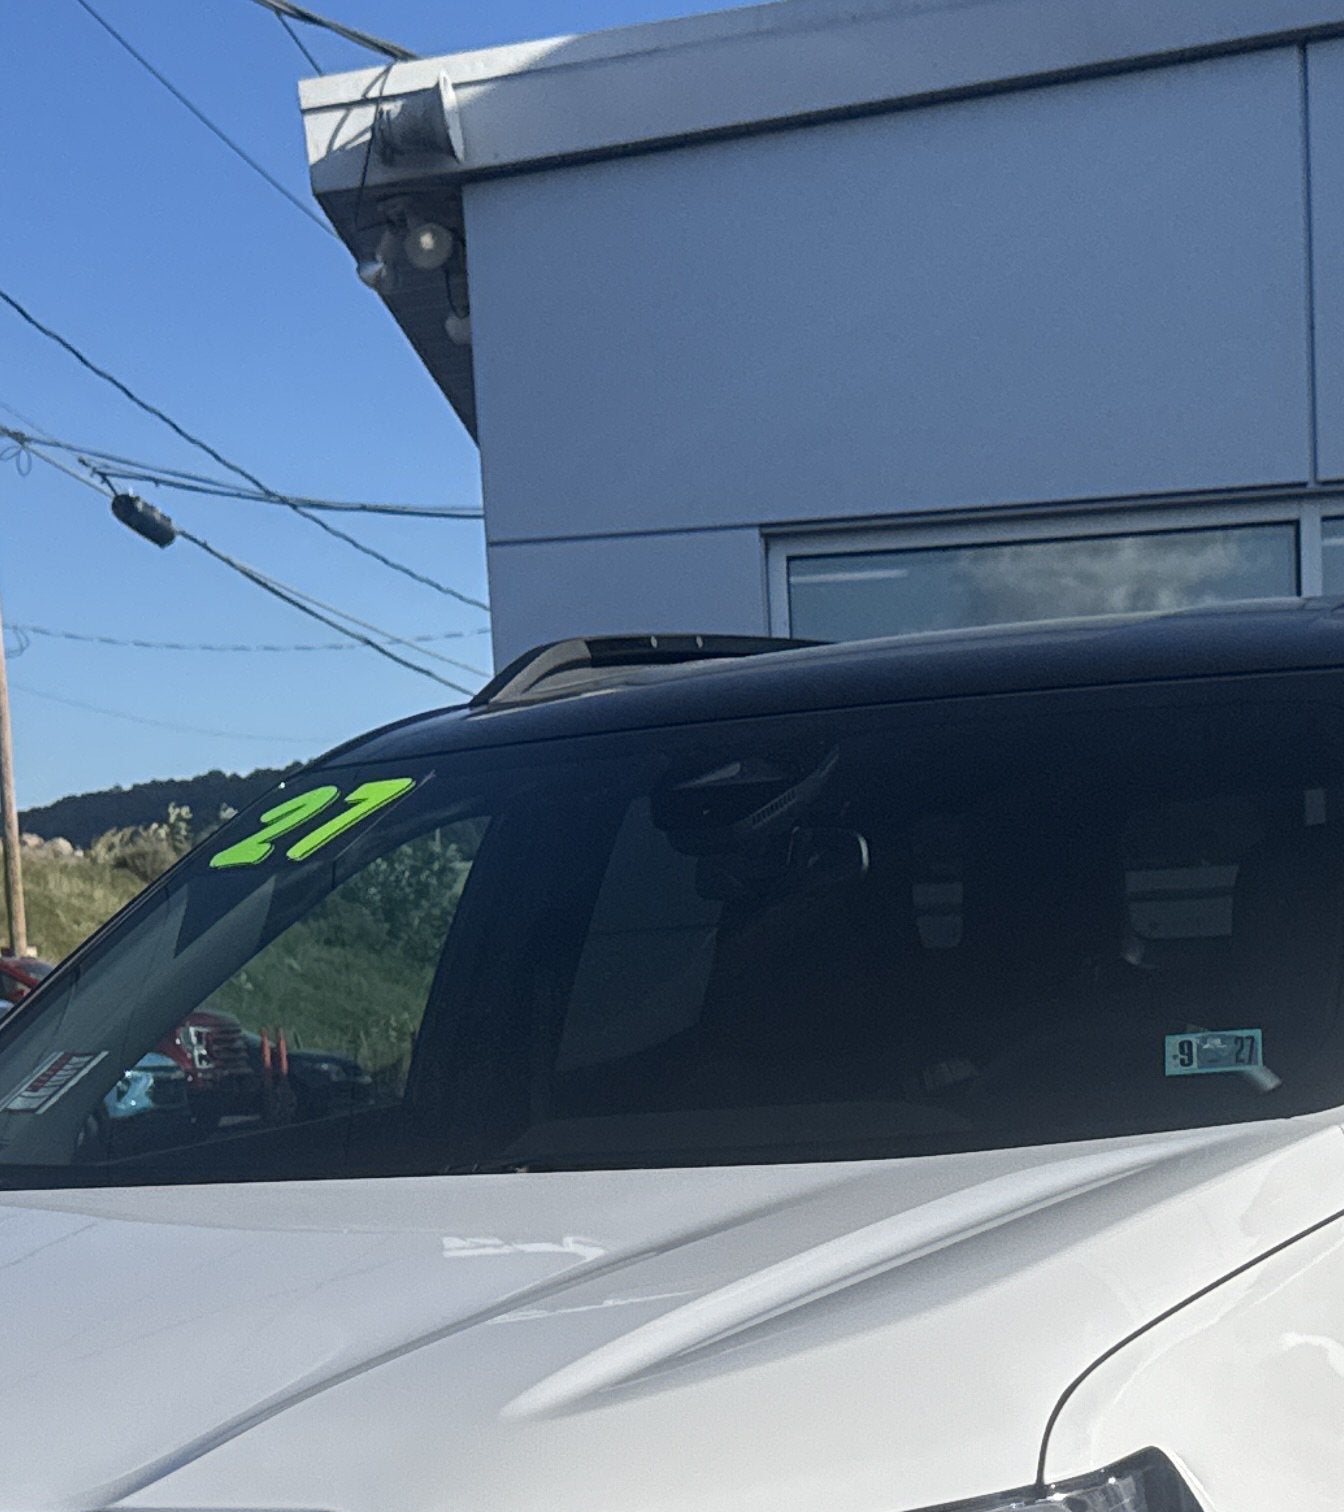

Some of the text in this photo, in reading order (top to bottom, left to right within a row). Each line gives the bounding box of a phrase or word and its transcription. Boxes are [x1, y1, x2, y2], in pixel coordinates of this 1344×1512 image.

[209, 777, 416, 868] 27
[1178, 1035, 1256, 1067] 9 27
